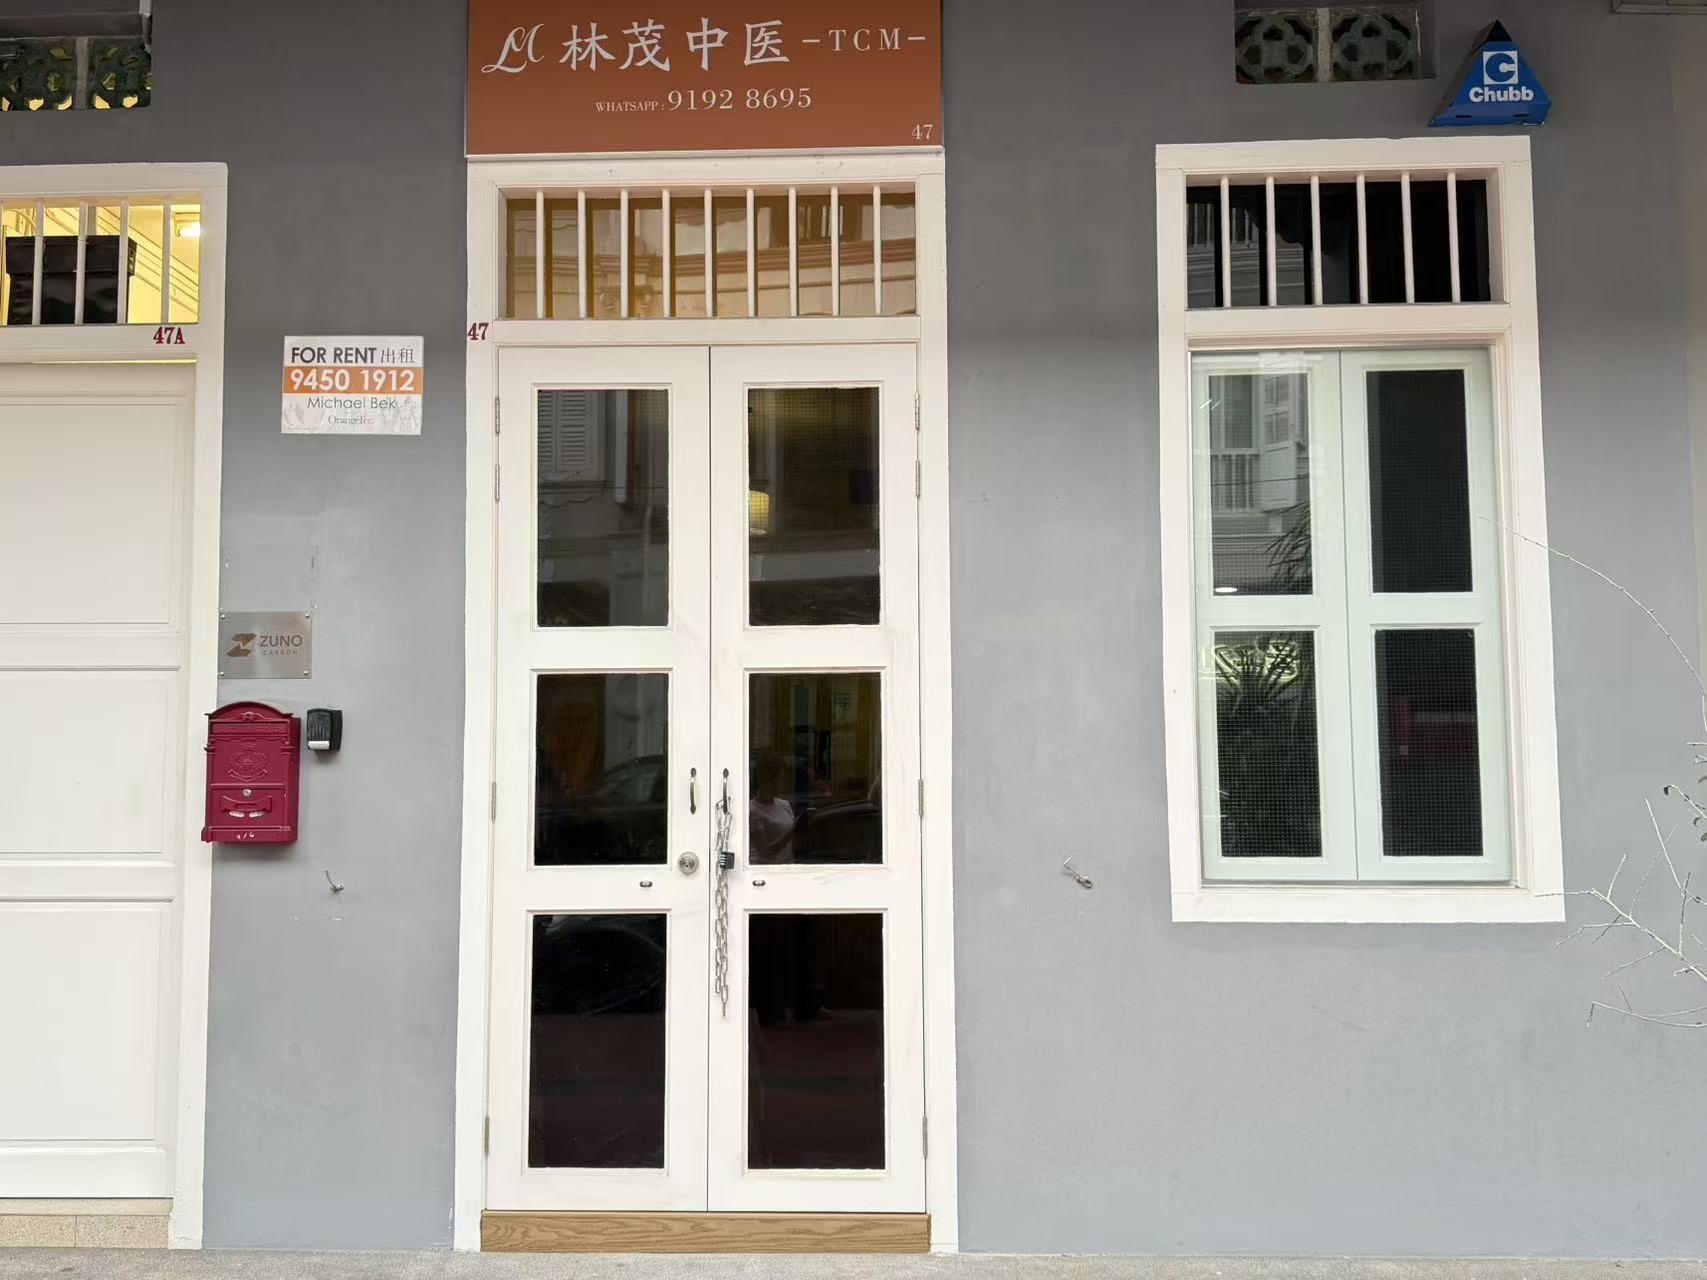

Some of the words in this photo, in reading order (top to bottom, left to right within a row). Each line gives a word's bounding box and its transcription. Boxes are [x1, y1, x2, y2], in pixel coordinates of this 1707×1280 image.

[559, 17, 790, 72] 林茂中医
[667, 89, 733, 111] 9192
[746, 87, 812, 109] 8695
[1468, 86, 1534, 103] Chubb
[911, 124, 933, 140] 47
[153, 327, 185, 344] 47A
[467, 322, 489, 340] 47
[291, 347, 327, 363] FOR
[333, 347, 377, 363] RENT
[381, 346, 415, 363] 出租
[290, 368, 350, 391] 9450
[360, 369, 414, 391] 1912
[308, 396, 366, 409] Michael
[370, 396, 396, 409] Bek
[259, 635, 303, 647] ZUNO
